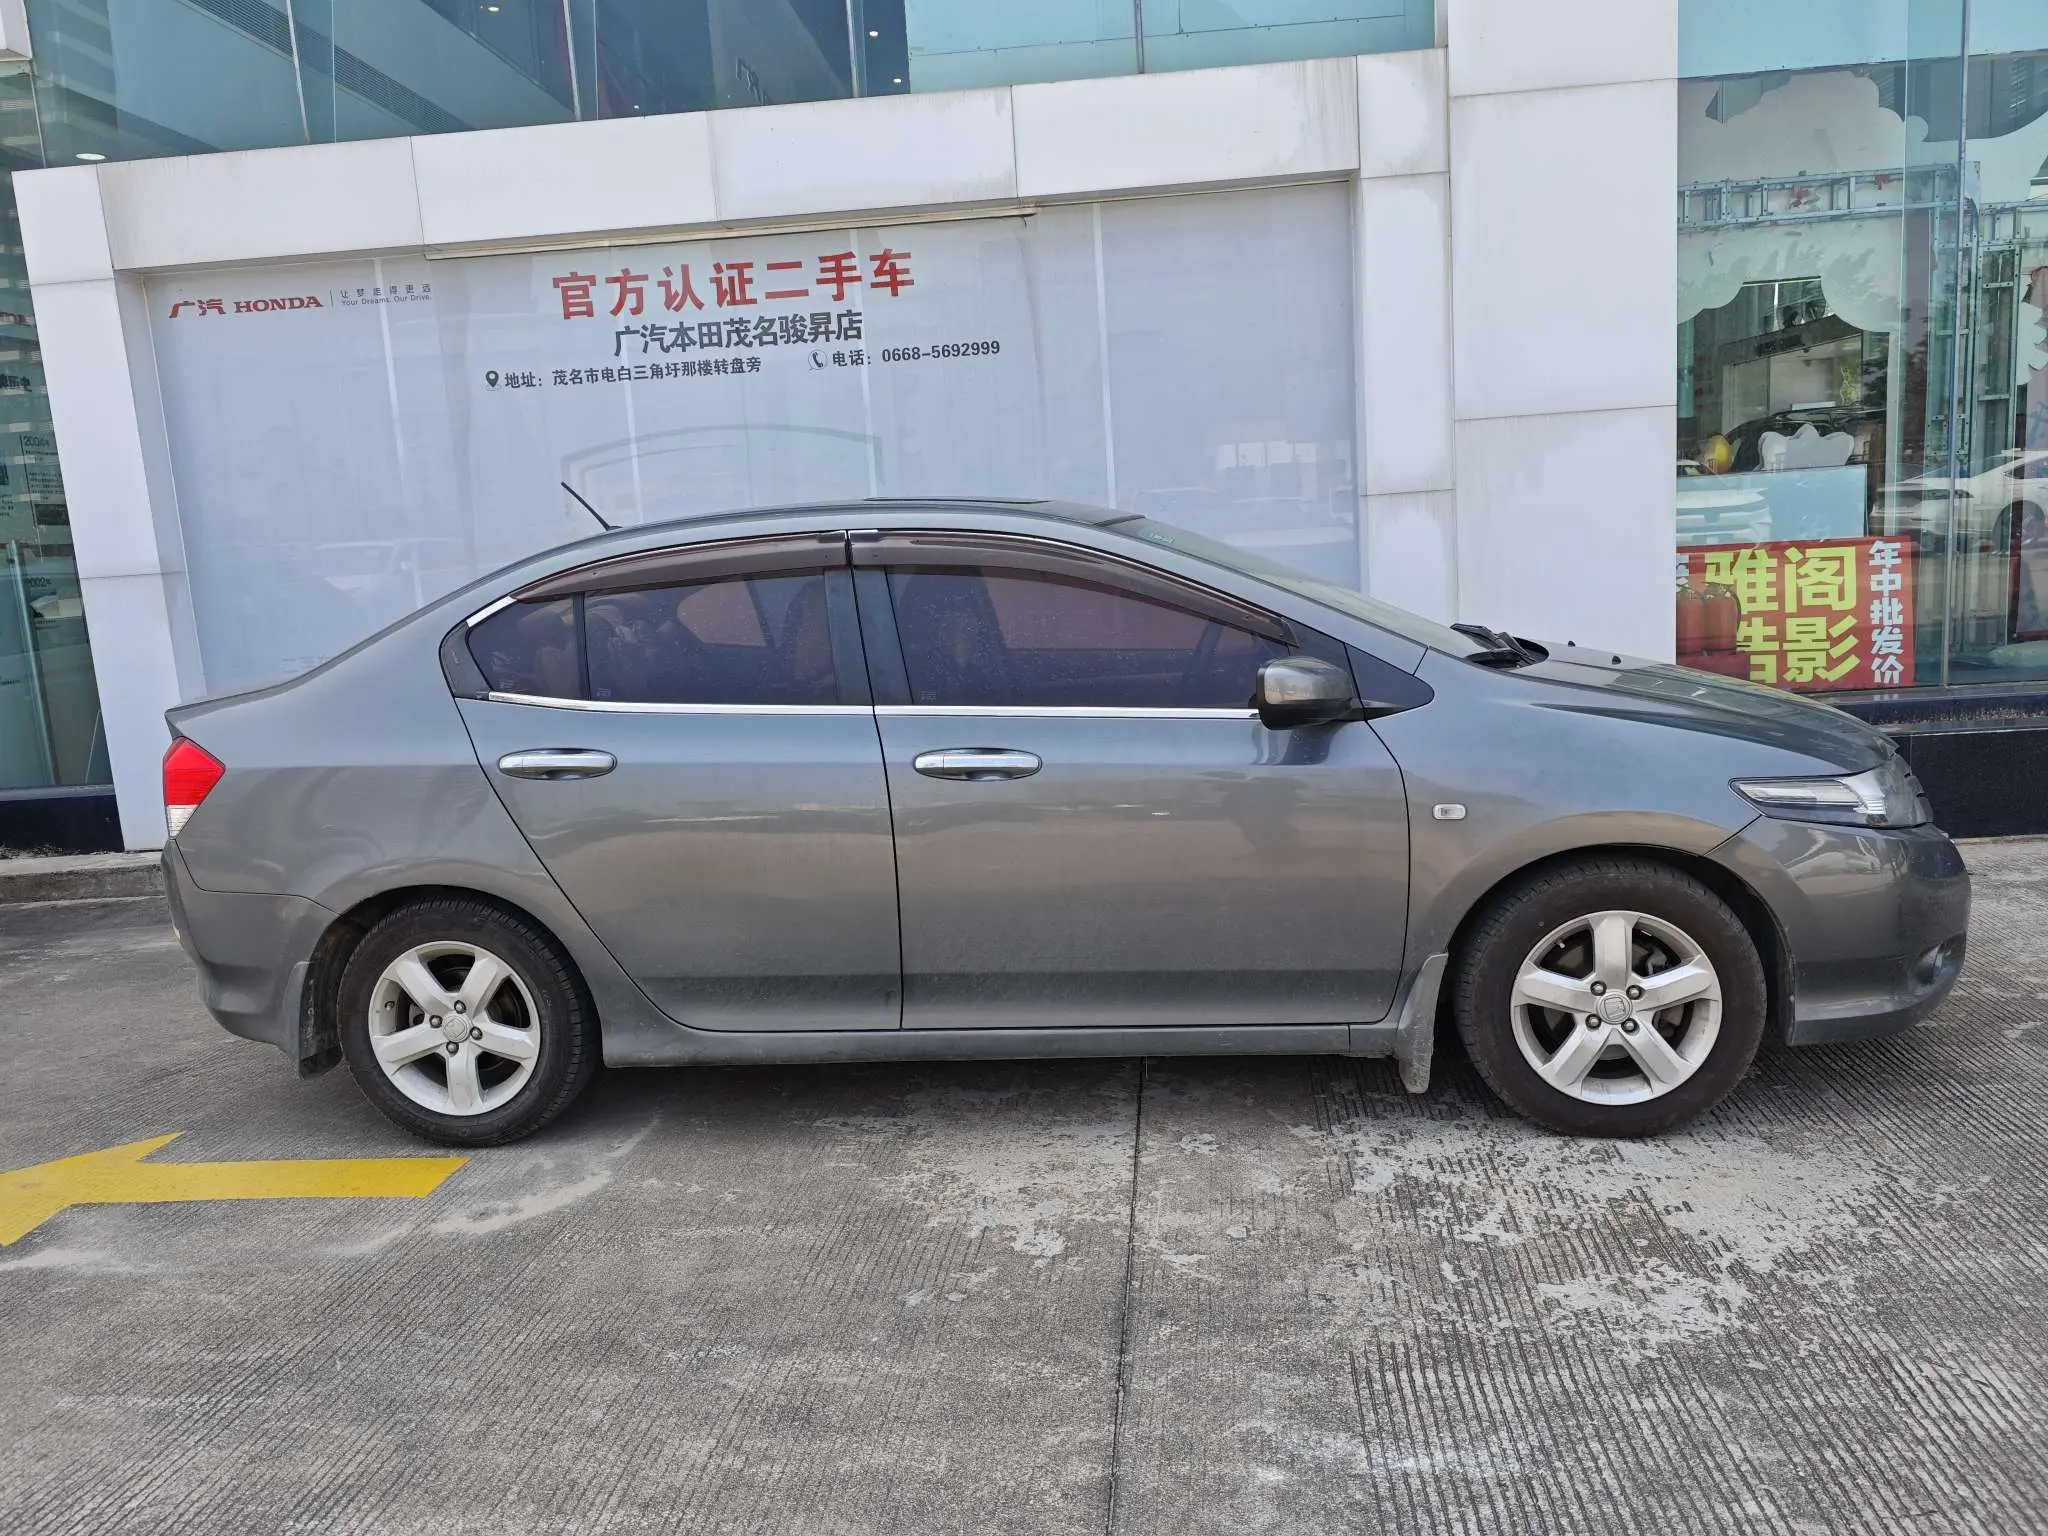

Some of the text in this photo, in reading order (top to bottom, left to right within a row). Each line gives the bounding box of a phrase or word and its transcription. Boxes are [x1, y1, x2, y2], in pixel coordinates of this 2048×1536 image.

[169, 296, 324, 318] 广汽 HONDA
[394, 295, 407, 303] Our
[552, 248, 915, 320] 官方认证二手车
[614, 309, 863, 356] 广汽本田茂名骏昇店
[1868, 540, 1905, 684] 年中批发价
